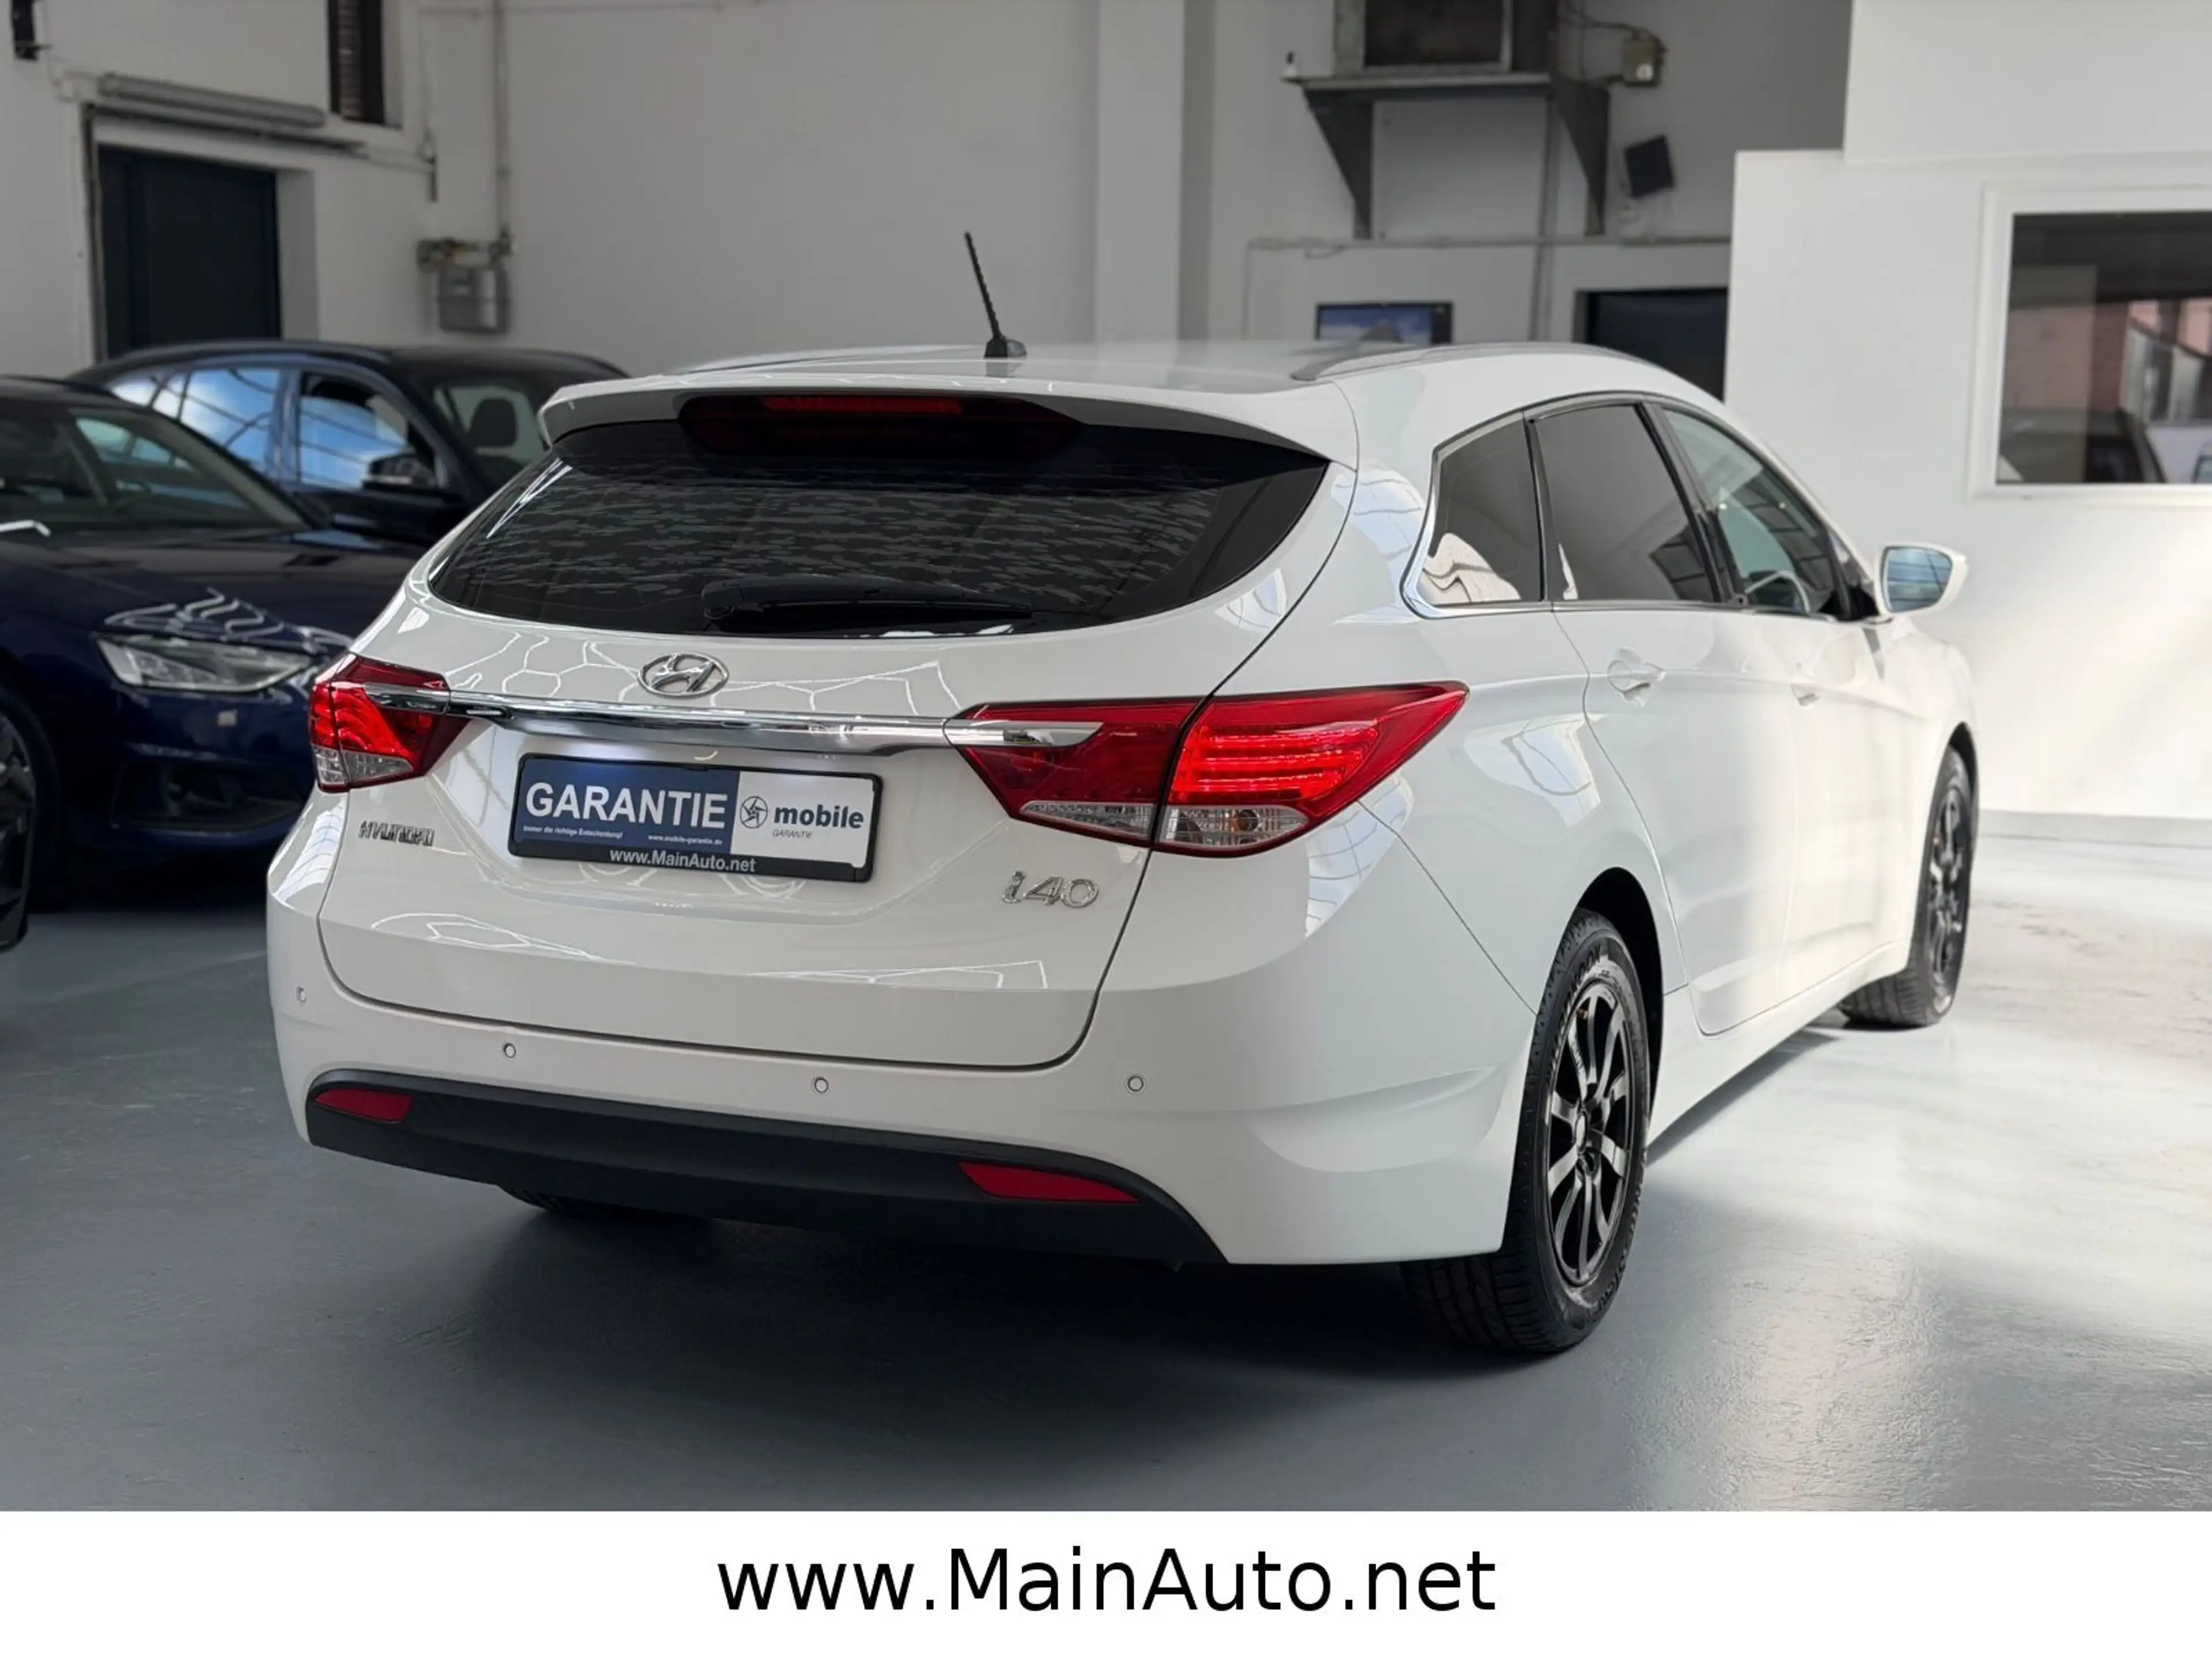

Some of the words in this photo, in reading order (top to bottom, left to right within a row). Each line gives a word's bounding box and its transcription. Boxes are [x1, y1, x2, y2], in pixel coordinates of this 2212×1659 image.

[525, 782, 729, 829] GARANTIE
[774, 804, 864, 829] mobile
[358, 820, 435, 846] HYUNDAI
[772, 829, 813, 839] GARANTIE
[609, 849, 756, 873] www.MainAuto.net
[1002, 870, 1100, 909] i40
